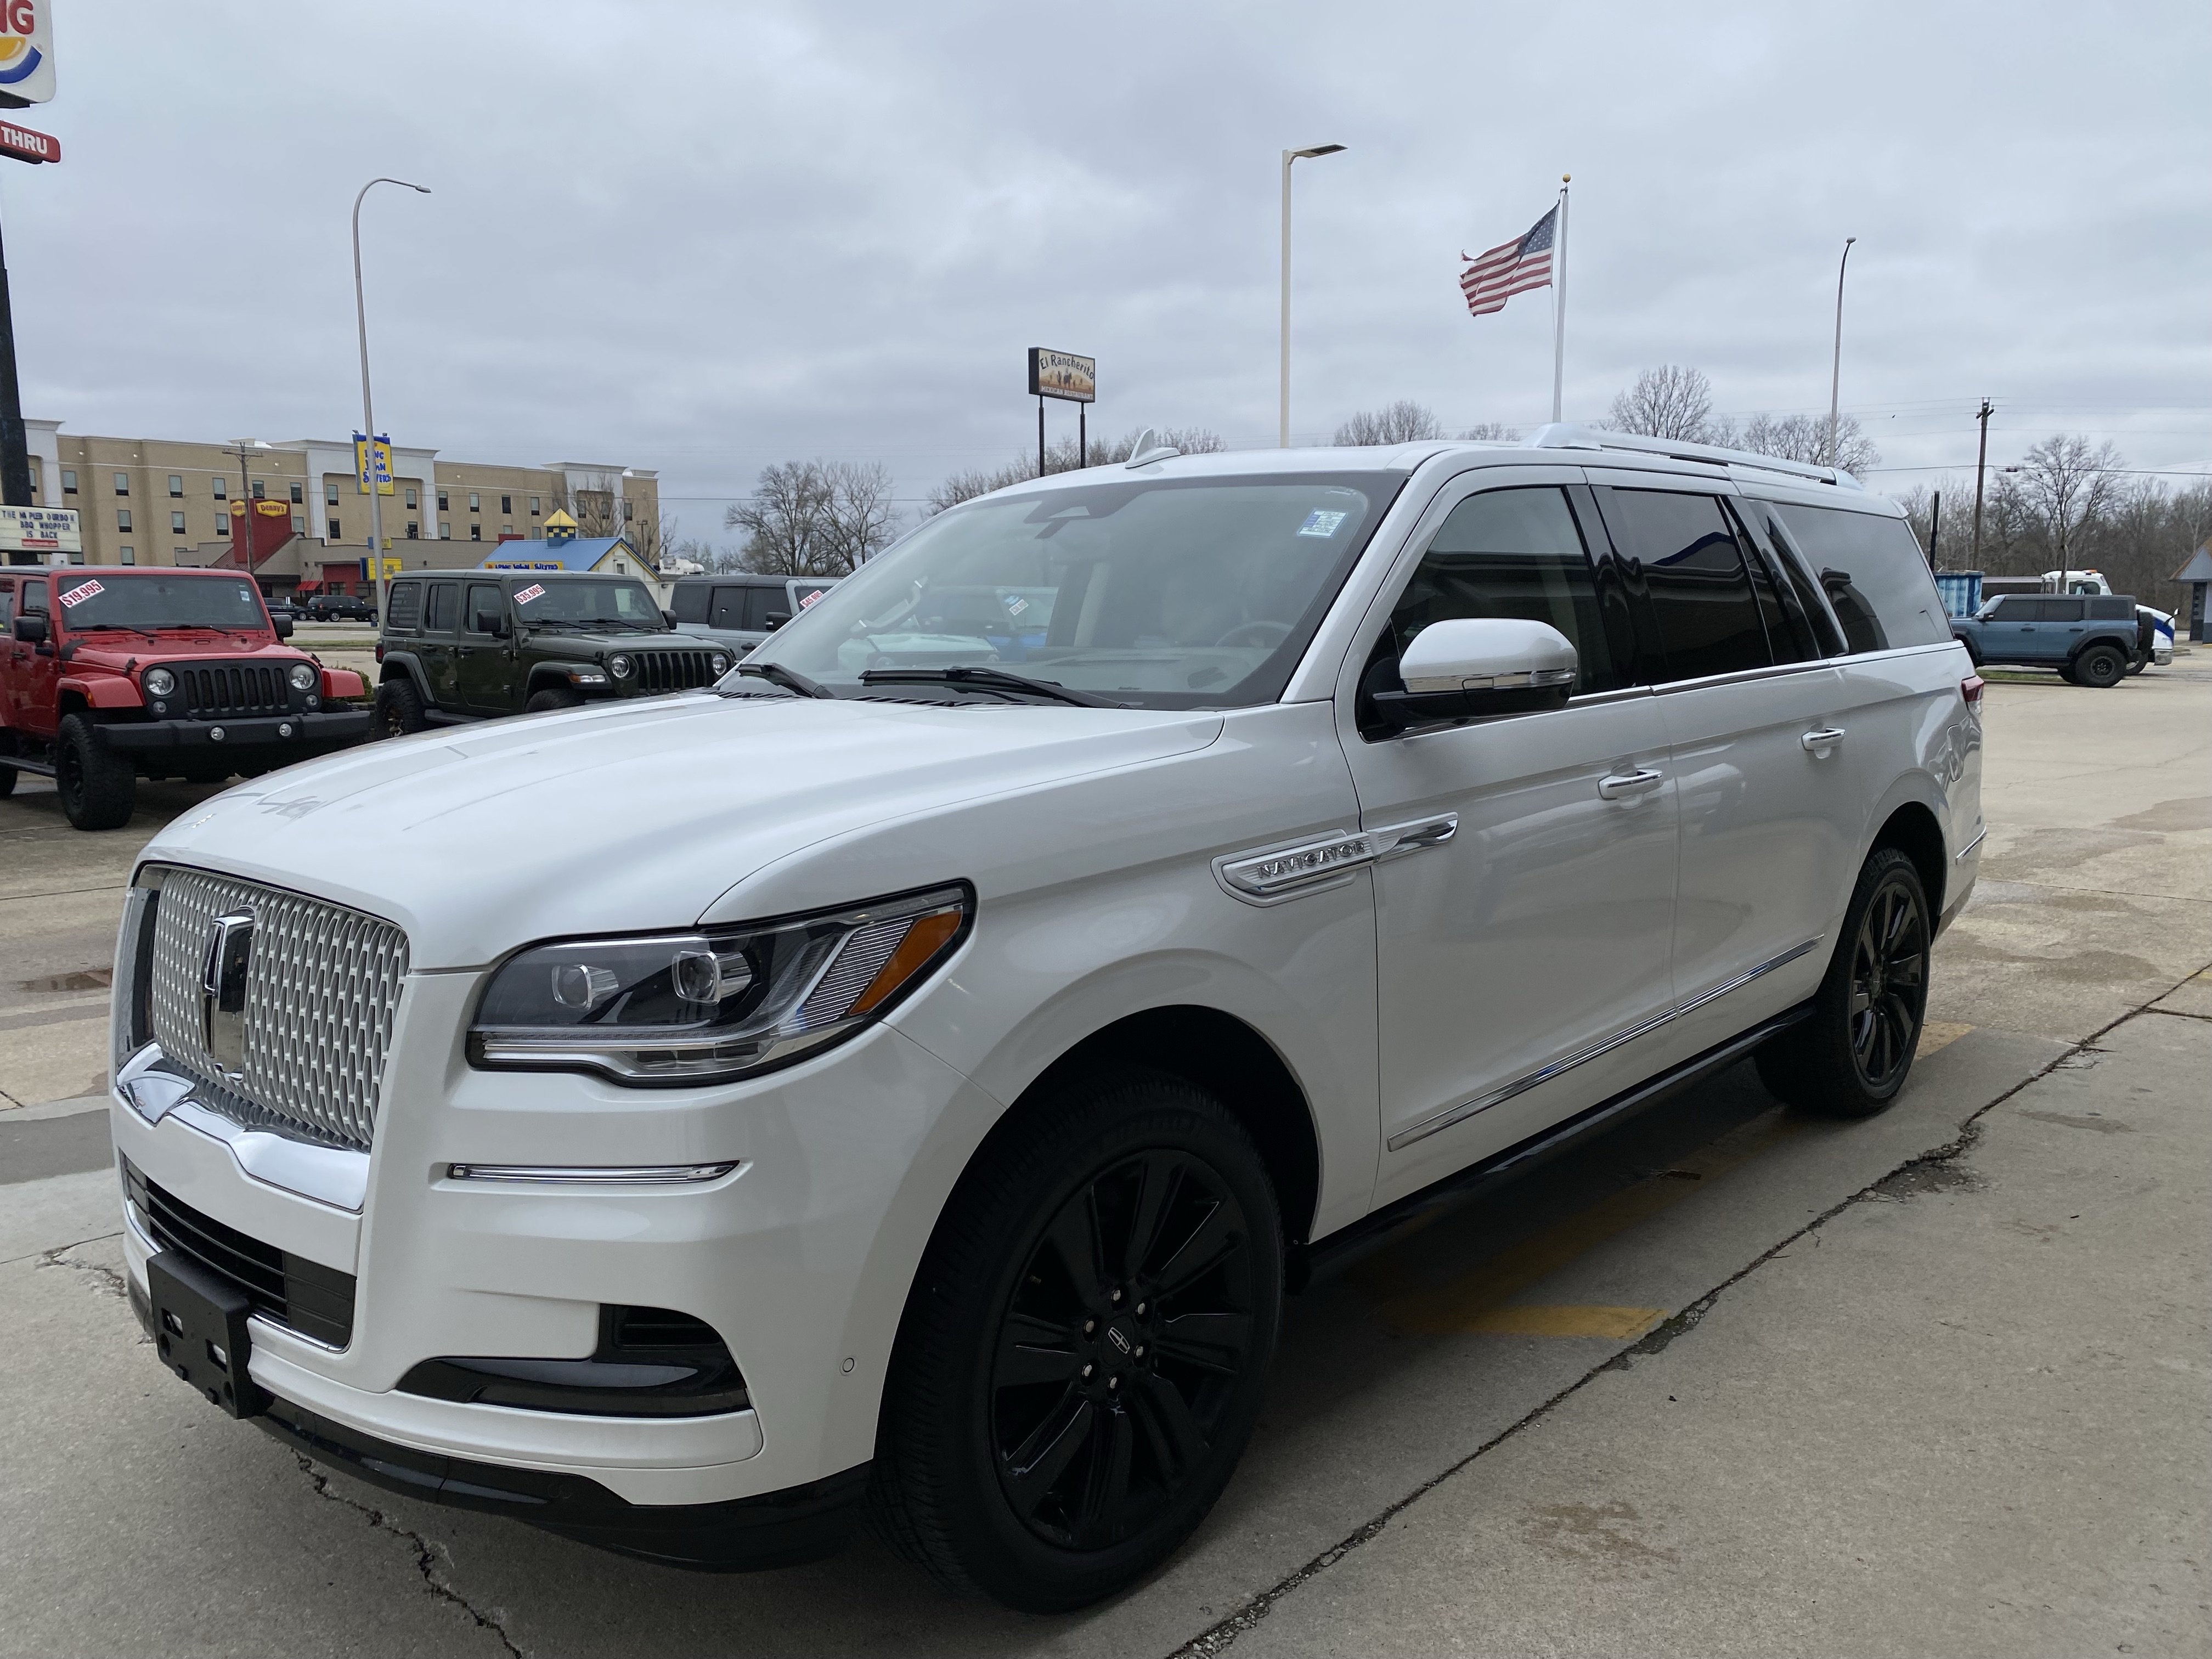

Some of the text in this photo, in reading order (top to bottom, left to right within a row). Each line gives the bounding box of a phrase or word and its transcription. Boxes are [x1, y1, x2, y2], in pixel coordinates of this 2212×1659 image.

[1, 126, 48, 154] THRU
[1040, 354, 1094, 380] El Rancherito
[39, 522, 70, 531] WHOPPER
[61, 581, 102, 606] $19,995
[516, 585, 544, 603] $35,995
[1256, 840, 1365, 878] NAVIGATOR
